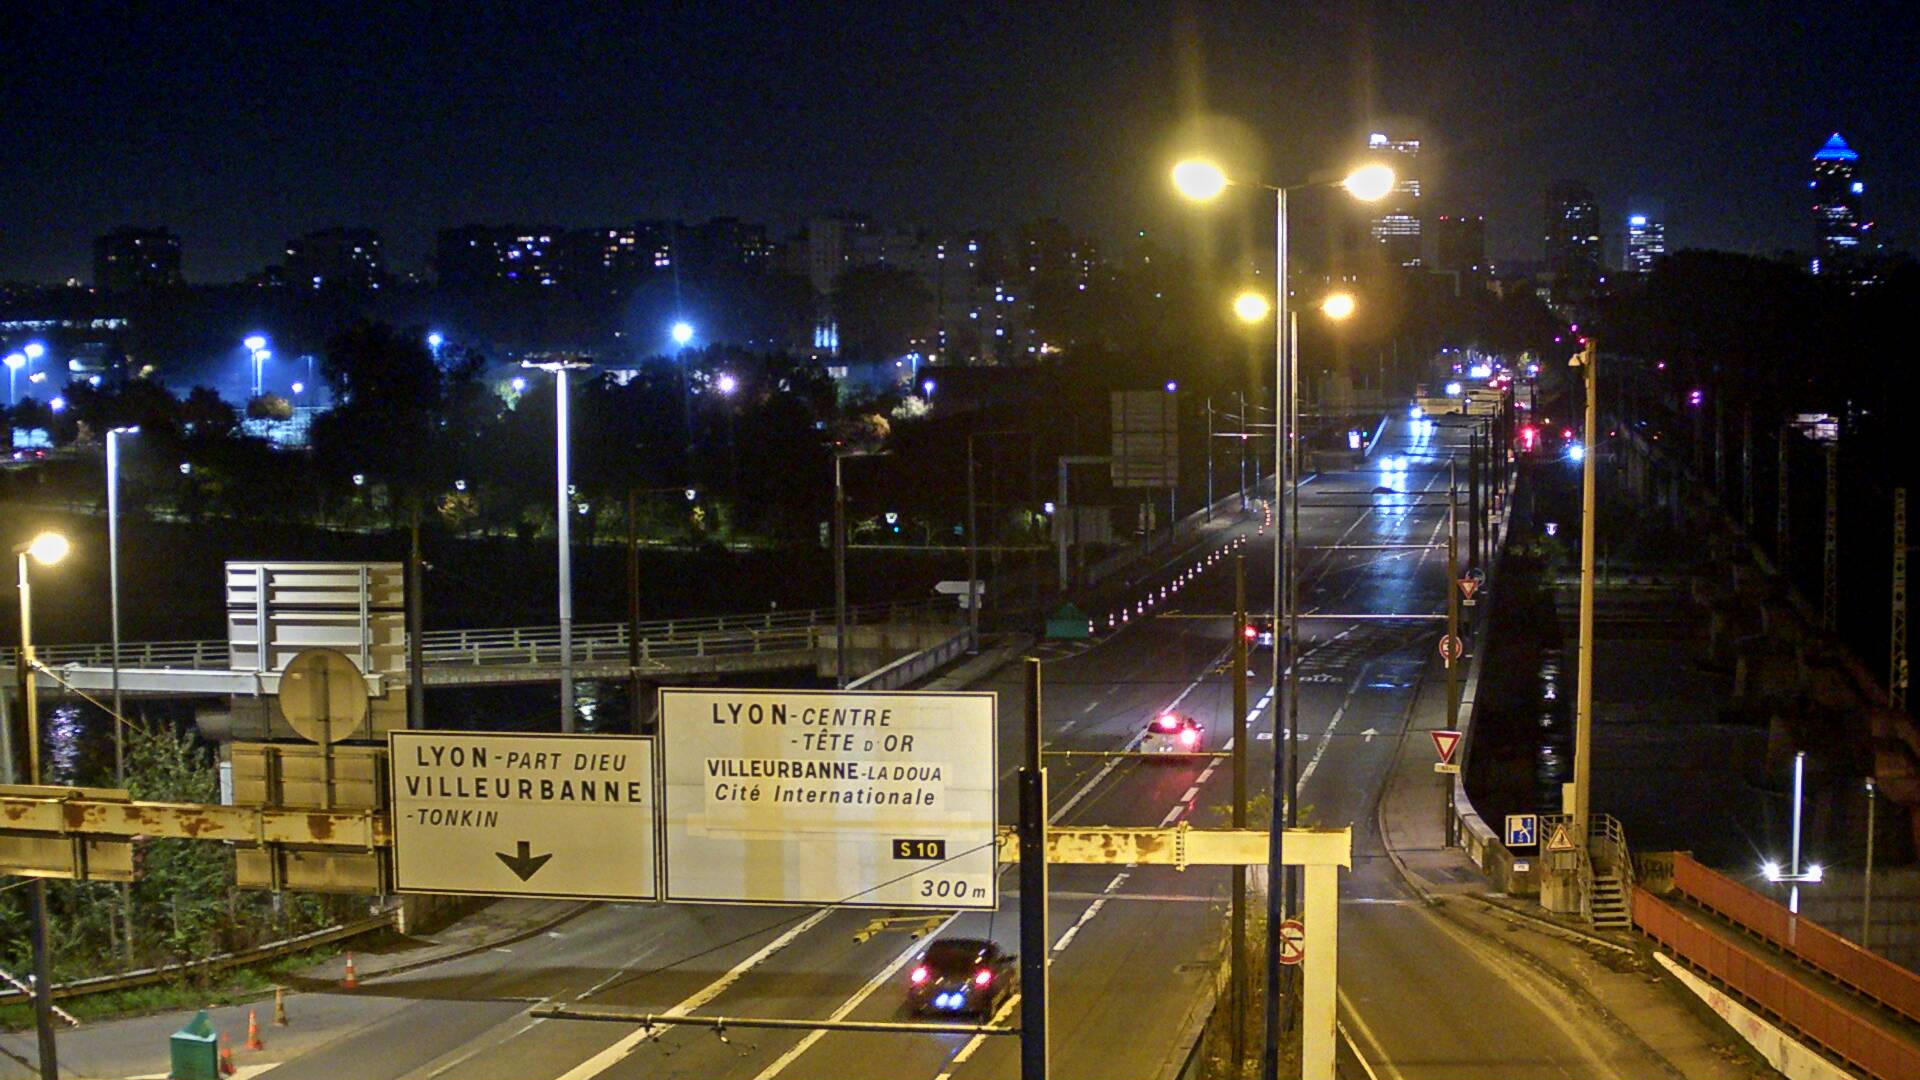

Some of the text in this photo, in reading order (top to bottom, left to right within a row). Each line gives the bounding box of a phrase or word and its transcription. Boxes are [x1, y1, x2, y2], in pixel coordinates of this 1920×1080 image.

[712, 703, 892, 727] LYON-CENTRE
[574, 753, 627, 772] DIEU
[893, 766, 942, 782] DOUA
[405, 775, 642, 803] VILLEURBANNE
[715, 783, 935, 806] Cité Internationale
[920, 879, 986, 898] 300 m
